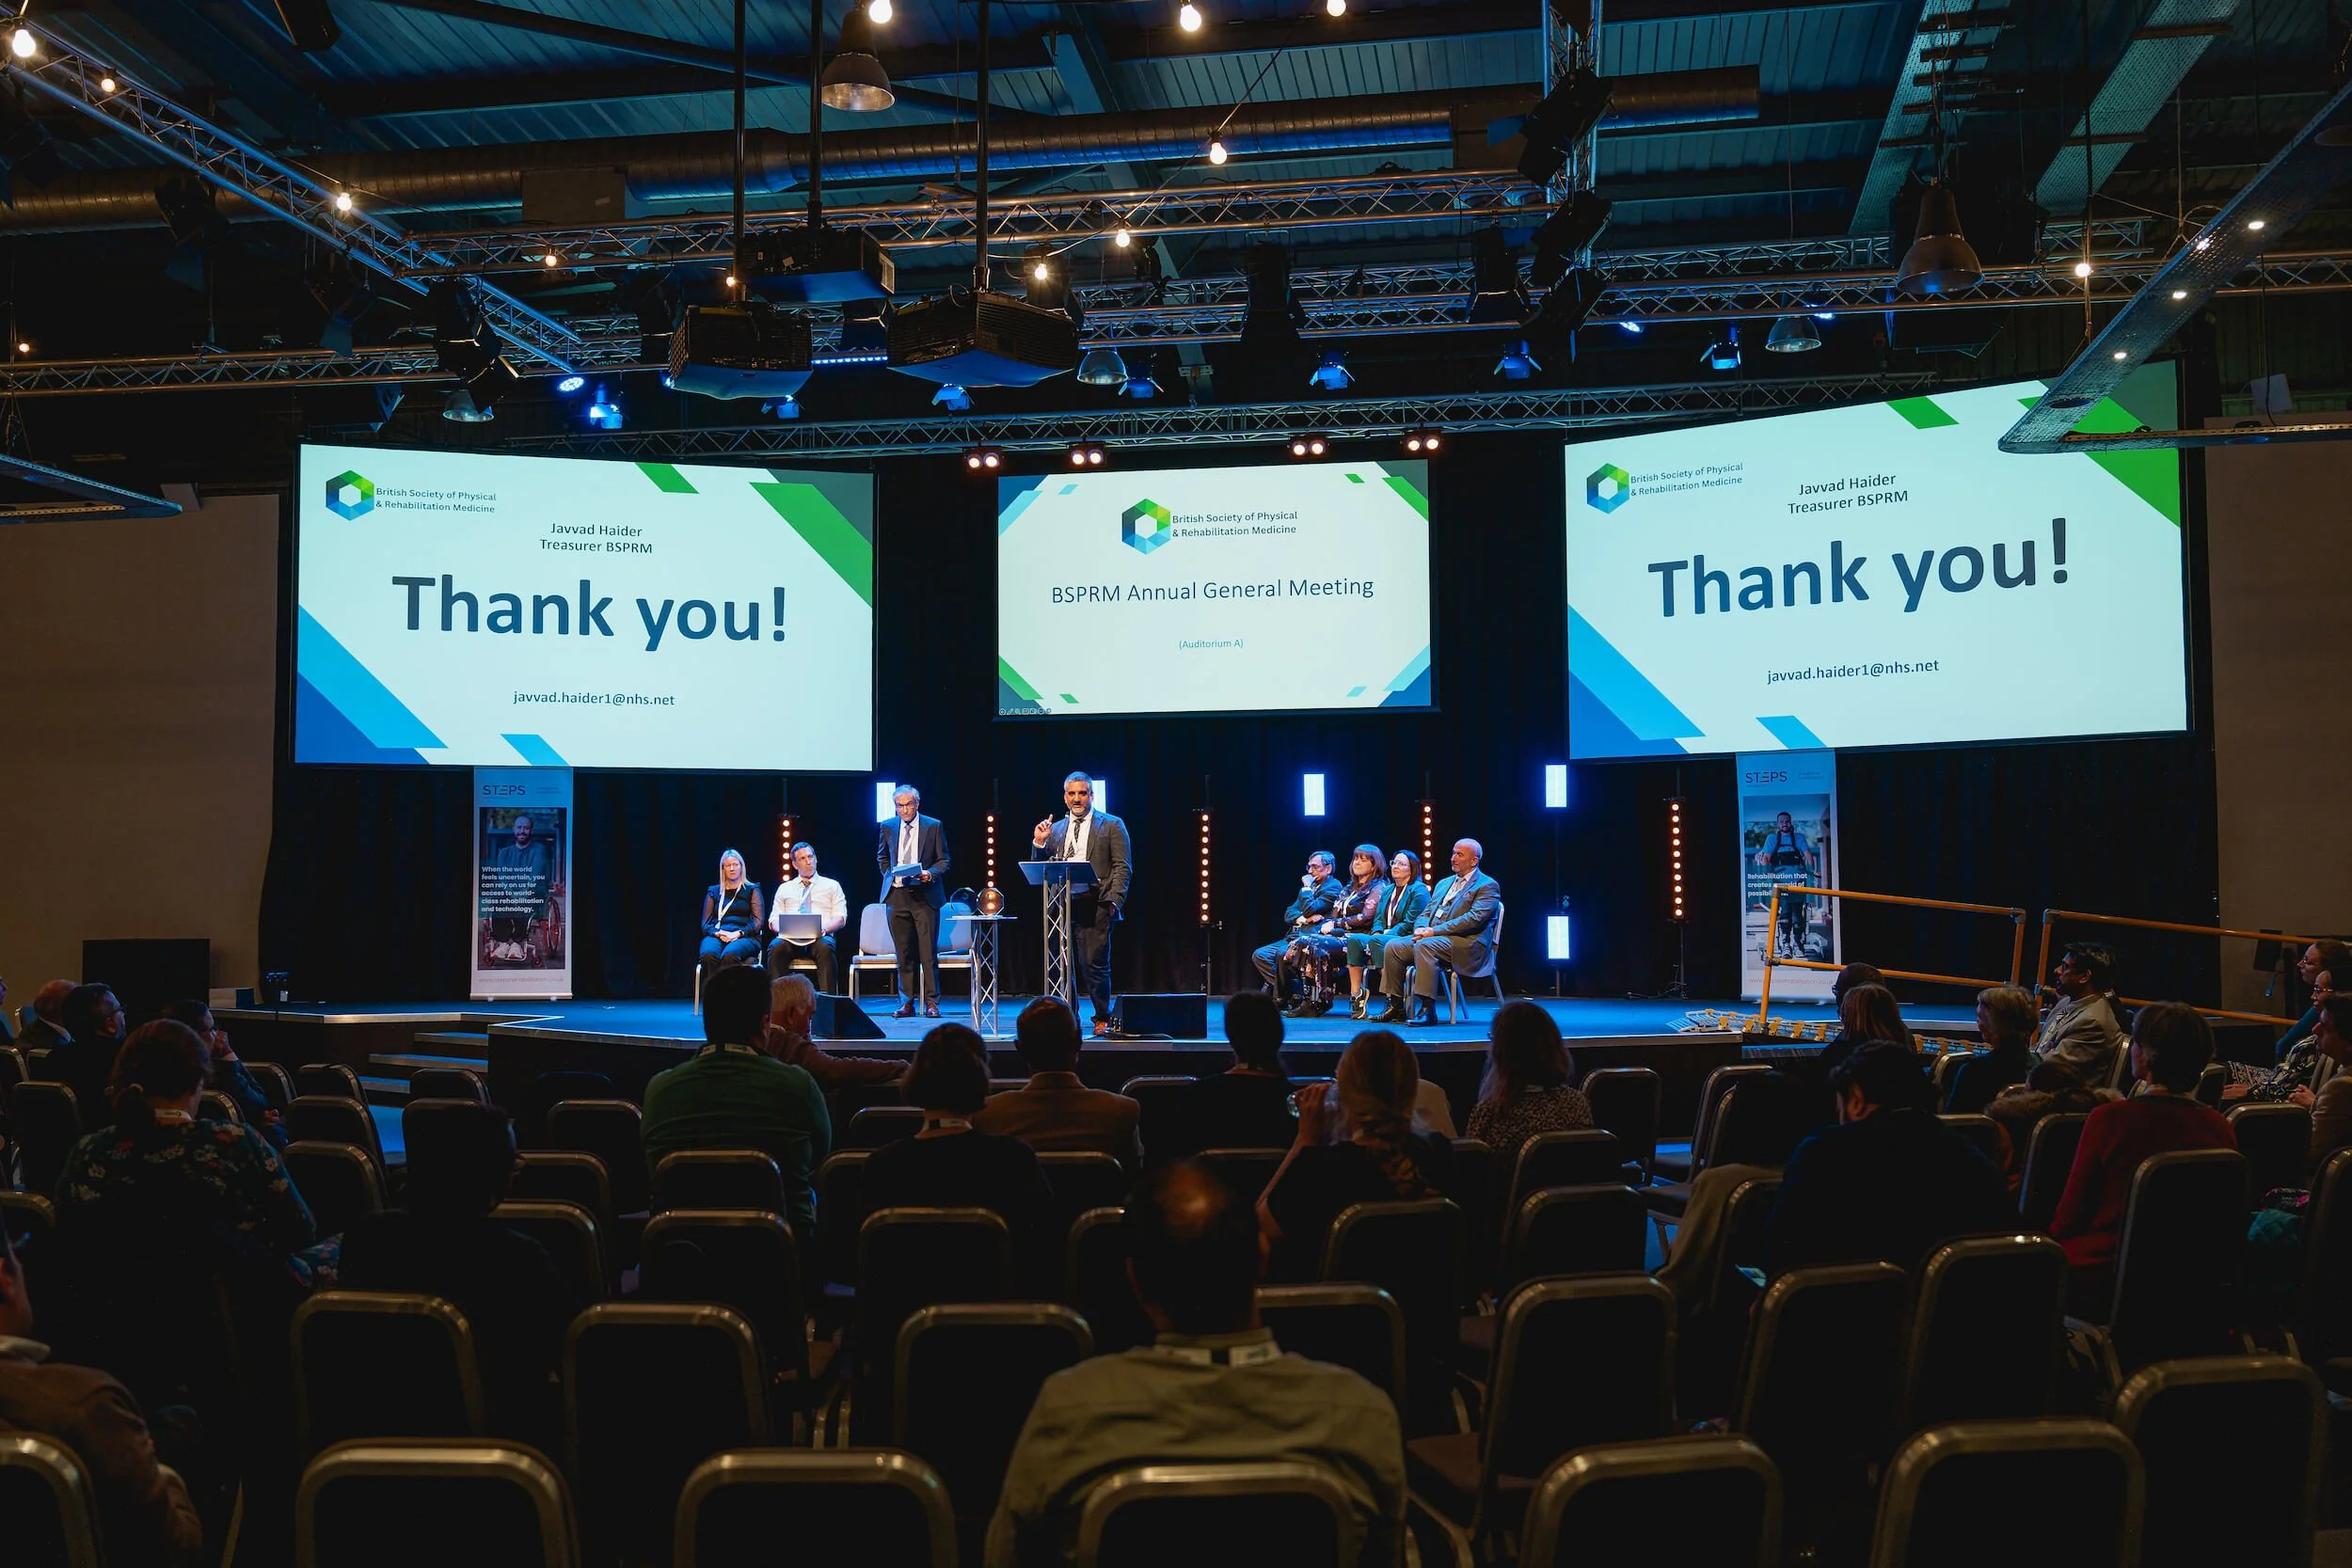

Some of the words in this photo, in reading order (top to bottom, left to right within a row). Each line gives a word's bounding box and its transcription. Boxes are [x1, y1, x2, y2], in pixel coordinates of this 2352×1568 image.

[1629, 473, 1659, 485] British
[1660, 469, 1694, 482] Society
[1694, 467, 1706, 478] of
[1707, 462, 1744, 476] Physical
[1630, 488, 1638, 498] &
[1638, 481, 1699, 496] Rehabilitation
[1701, 477, 1743, 490] Medicine
[1798, 478, 1846, 497] Javvad
[1849, 473, 1898, 492] Haider
[375, 486, 406, 498] British
[408, 488, 445, 500] Society
[446, 489, 456, 500] of
[457, 491, 497, 503] Physical
[1788, 498, 1853, 515] Treasurer
[1856, 489, 1909, 508] BSPRM
[375, 499, 383, 509] &
[384, 499, 451, 512] Rehabilitation
[453, 502, 496, 514] Medicine
[1171, 513, 1204, 525] British
[1205, 512, 1243, 524] Society
[1244, 511, 1256, 522] of
[1256, 510, 1298, 522] Physical
[549, 523, 596, 537] Javvad
[598, 524, 644, 539] Haider
[1172, 528, 1179, 538] &
[1181, 526, 1249, 538] Rehabilitation
[1251, 524, 1296, 535] Medicine
[539, 538, 602, 553] Treasurer
[606, 540, 653, 555] BSPRM
[1647, 539, 1870, 619] Thank
[1891, 517, 2069, 613] you!
[1051, 585, 1120, 605] BSPRM
[1127, 581, 1197, 602] Annual
[1202, 578, 1282, 600] General
[1288, 578, 1375, 600] Meeting
[391, 573, 614, 638] Thank
[635, 586, 787, 653] you!
[1178, 639, 1232, 650] (Auditorium
[1232, 639, 1244, 650] A)
[1766, 659, 1940, 686] javvad.haider1@nhs.net
[512, 689, 675, 707] javvad.haider1@nhs.net
[1745, 770, 1788, 784] STEPS
[482, 784, 526, 796] STEPS
